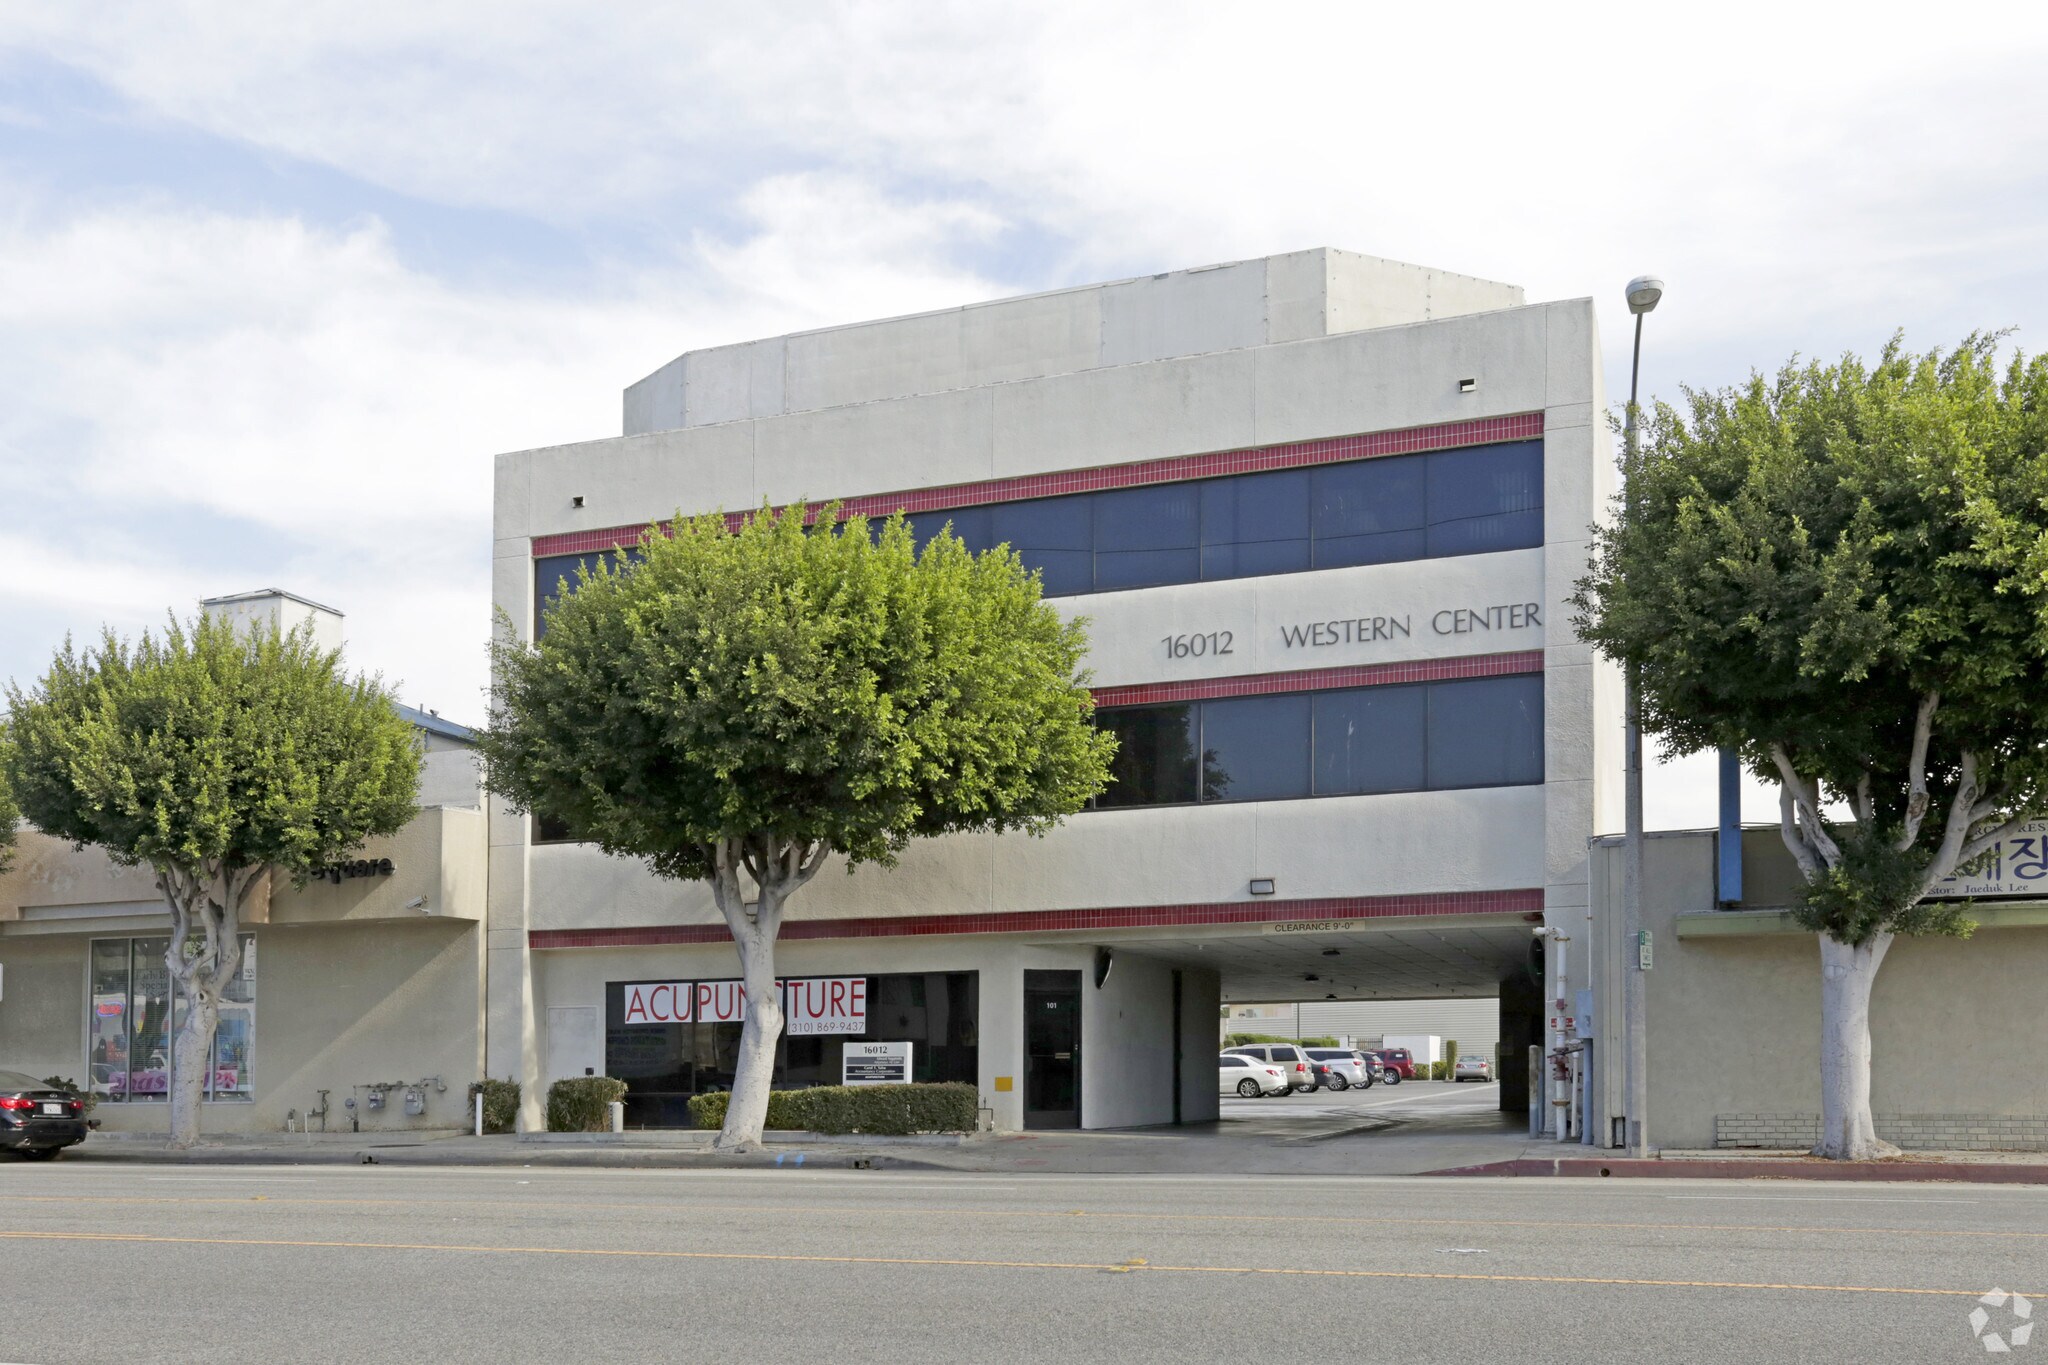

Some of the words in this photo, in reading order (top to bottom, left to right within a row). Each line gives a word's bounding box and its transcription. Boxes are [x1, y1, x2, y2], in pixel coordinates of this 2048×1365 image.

[1161, 631, 1234, 659] 16012
[1281, 614, 1411, 648] WESTERN
[1432, 602, 1542, 635] CENTER
[1964, 883, 2003, 894] Jaeduk
[2009, 883, 2029, 892] Lee
[1274, 922, 1331, 933] CLEARANCE
[787, 1022, 814, 1034] (310)
[817, 1021, 865, 1032] 869-9437
[864, 1045, 888, 1054] 16012
